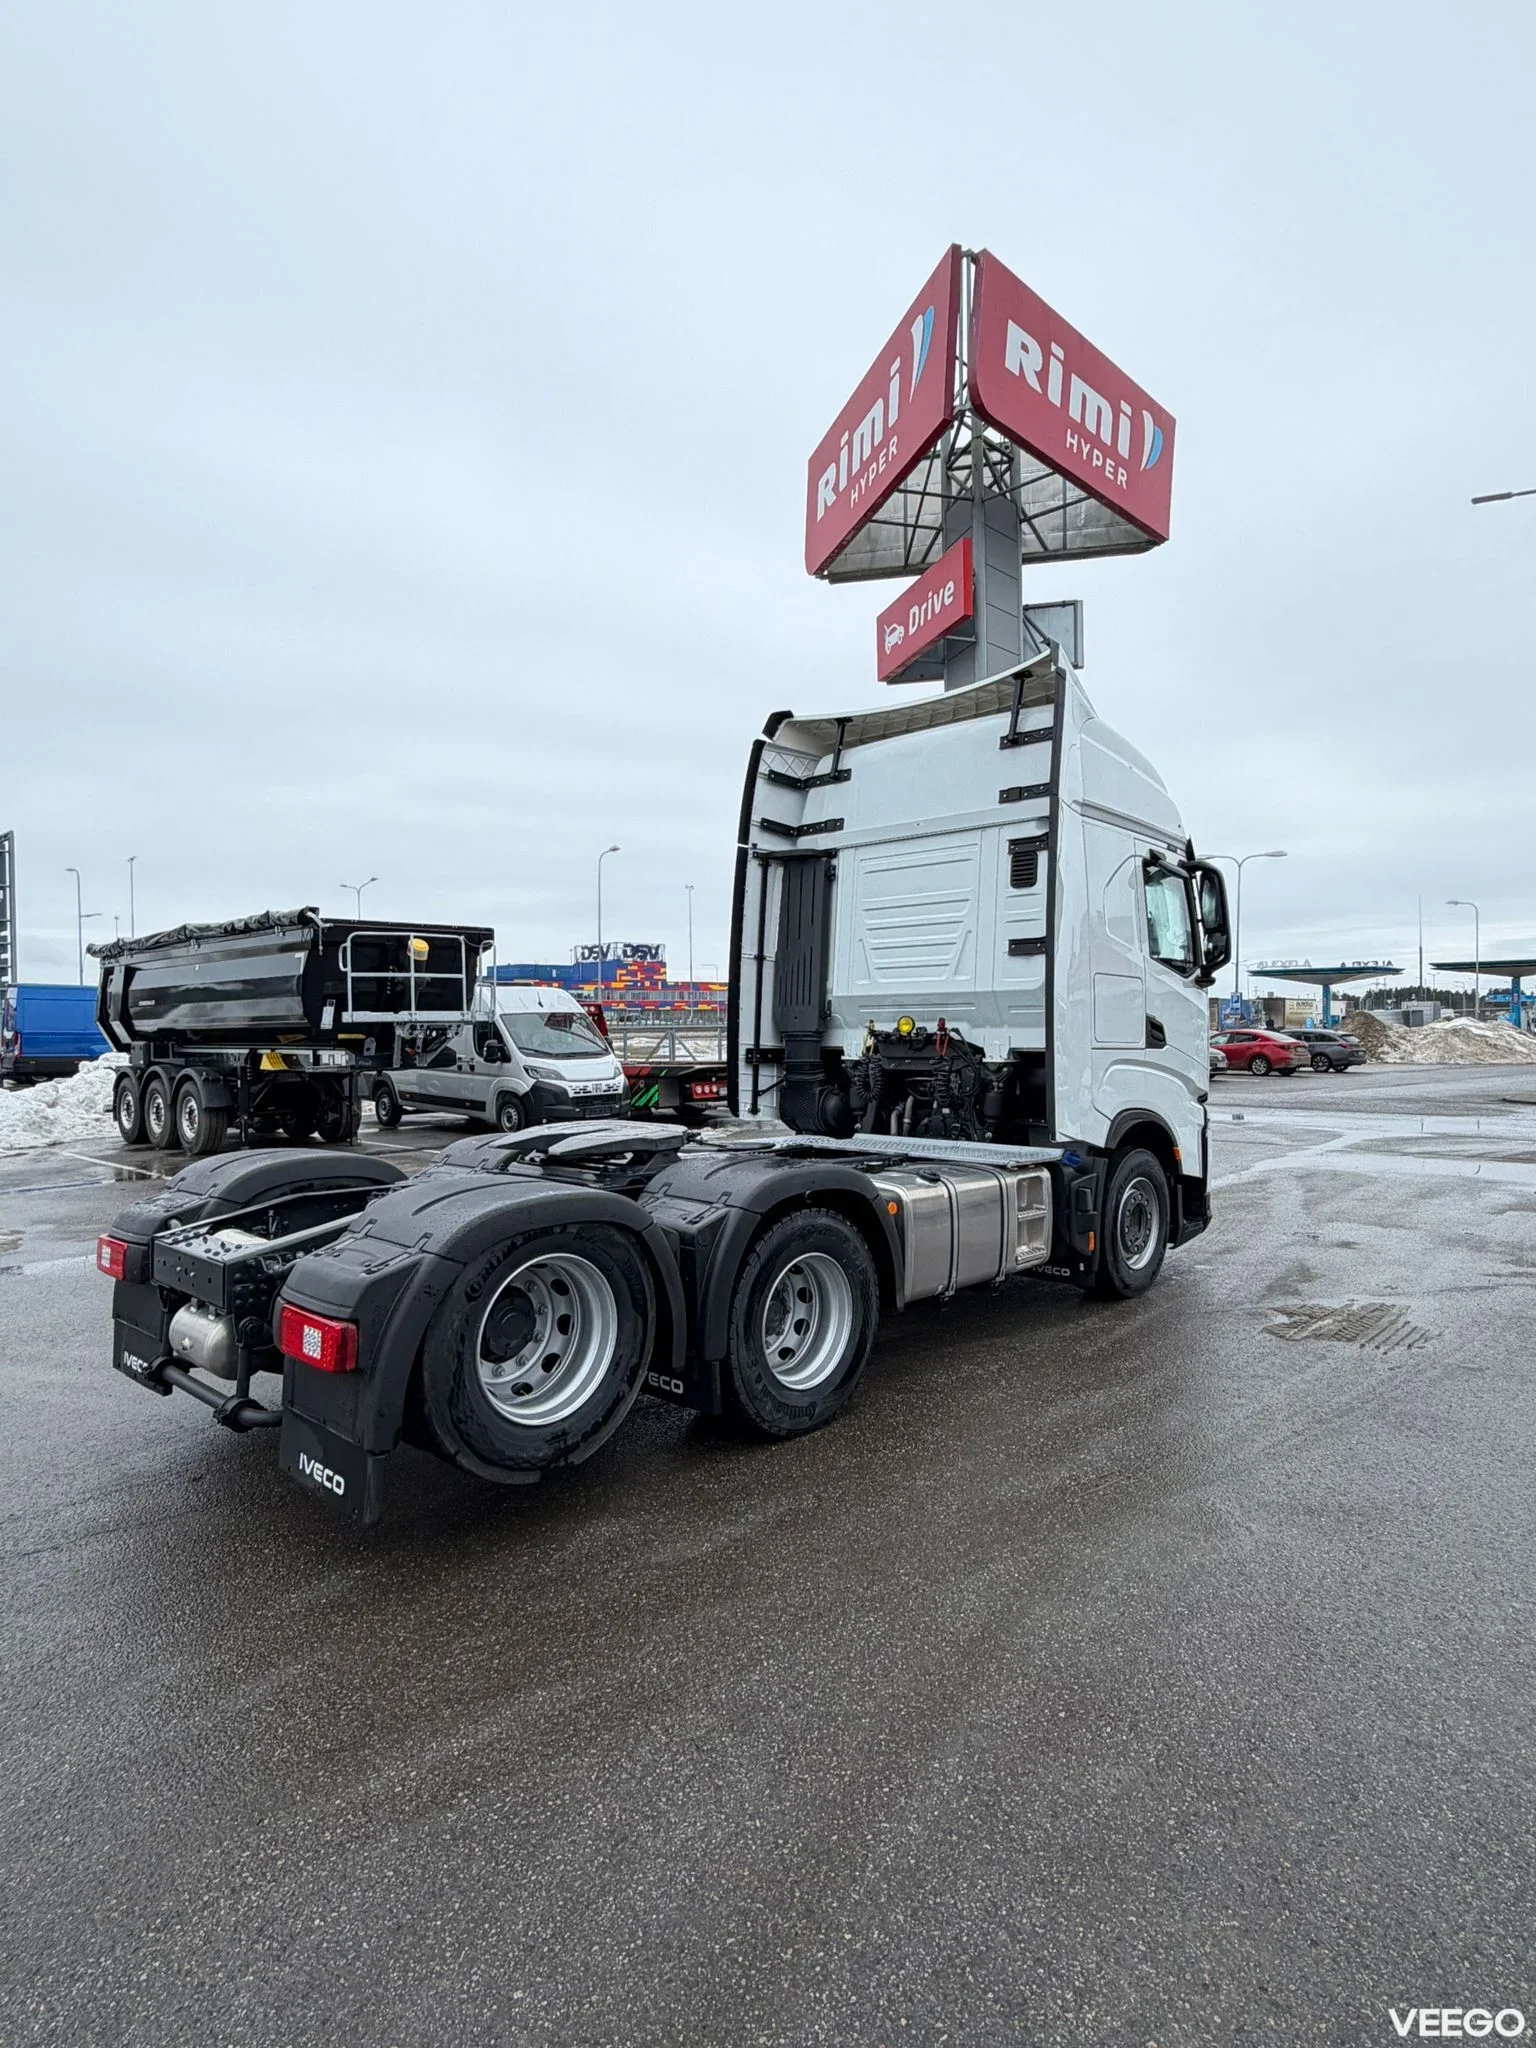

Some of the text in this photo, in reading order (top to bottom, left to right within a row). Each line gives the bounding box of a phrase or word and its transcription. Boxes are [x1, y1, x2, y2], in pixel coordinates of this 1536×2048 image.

[1004, 319, 1132, 460] Rimi
[817, 356, 901, 522] Rimi
[1066, 428, 1127, 490] HYPER
[850, 435, 898, 509] HYPER
[908, 580, 955, 636] Drive
[580, 943, 611, 961] DSV
[623, 943, 661, 960] DSV
[648, 1371, 684, 1394] ECO
[299, 1452, 345, 1496] IVECO
